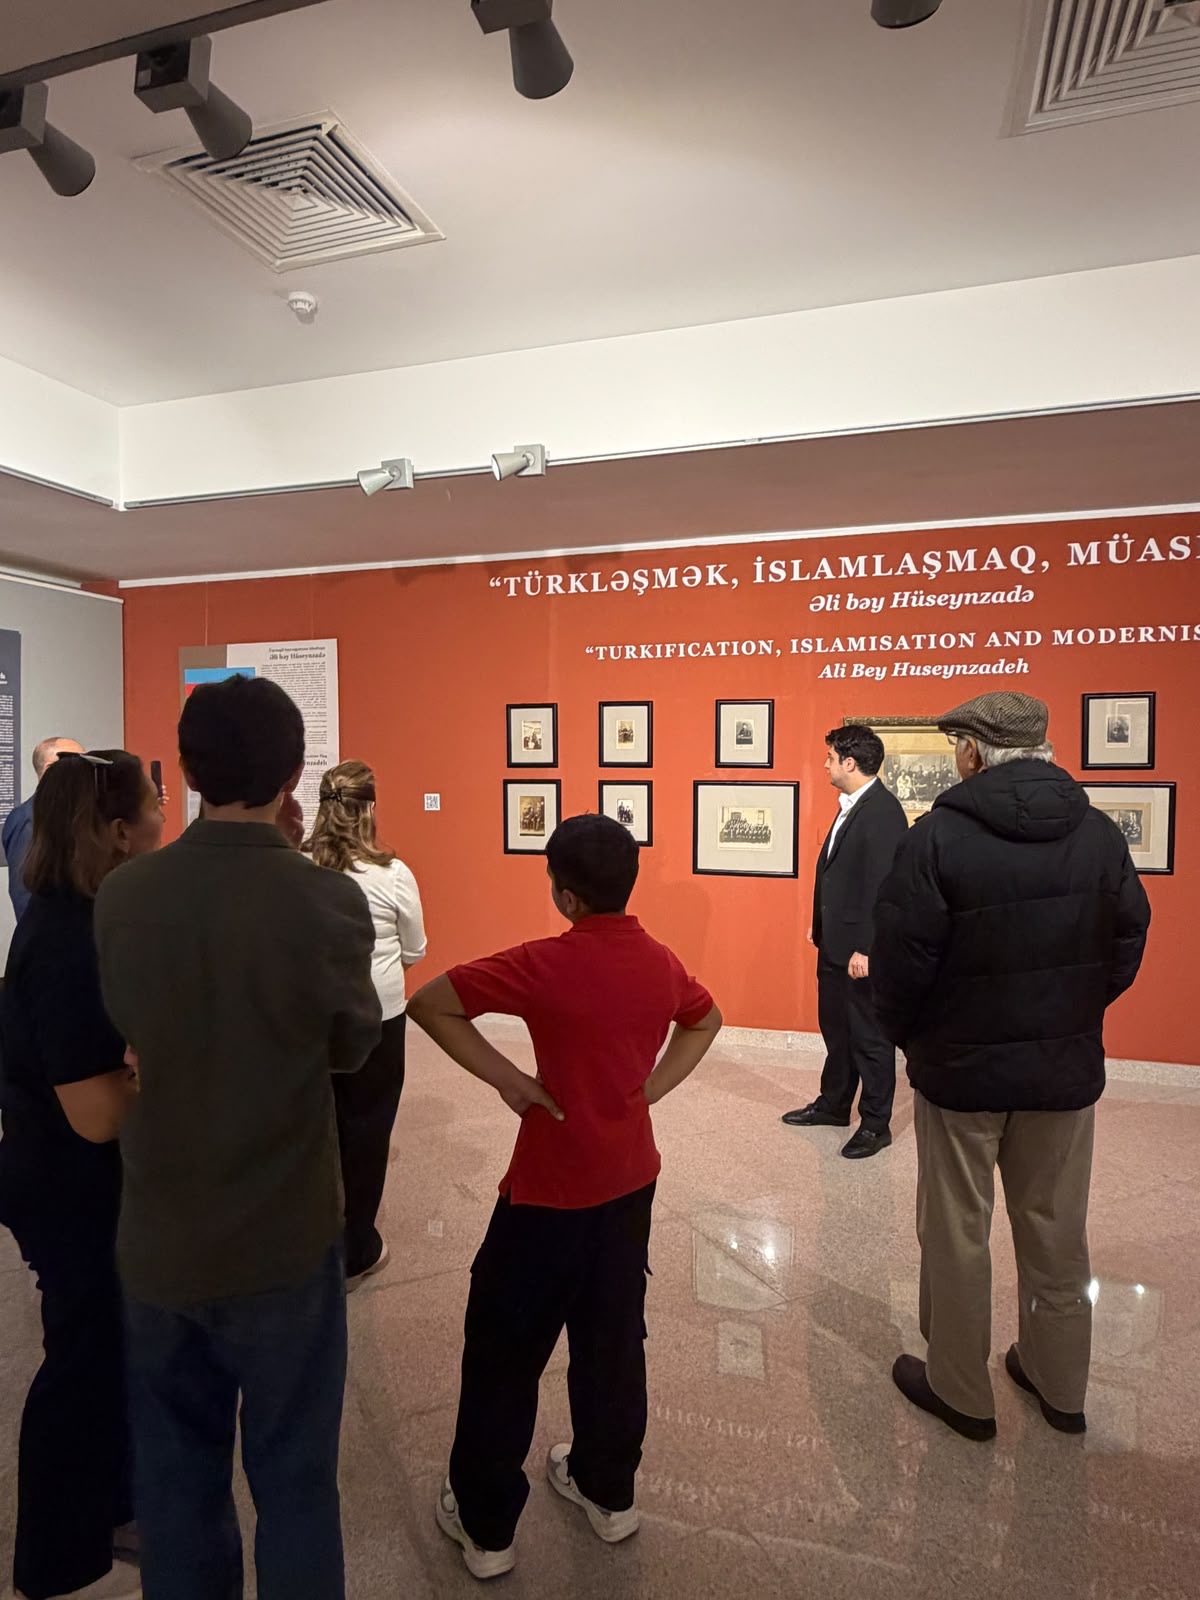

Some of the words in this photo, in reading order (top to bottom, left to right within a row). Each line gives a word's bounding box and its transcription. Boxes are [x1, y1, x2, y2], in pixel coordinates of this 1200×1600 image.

[489, 563, 739, 597] “TÜRKLƏŞMƏK,
[753, 545, 1050, 584] İSLAMLAŞMAQ,
[808, 593, 841, 613] Əli
[845, 592, 886, 614] bəy
[889, 584, 1035, 611] Hüseynzadə
[585, 639, 781, 661] “TURKIFICATION,
[790, 632, 977, 654] ISLAMISATION
[984, 630, 1042, 648] AND
[817, 662, 847, 679] Ali
[849, 663, 888, 681] Bey
[890, 657, 1030, 680] Huseynzadeh
